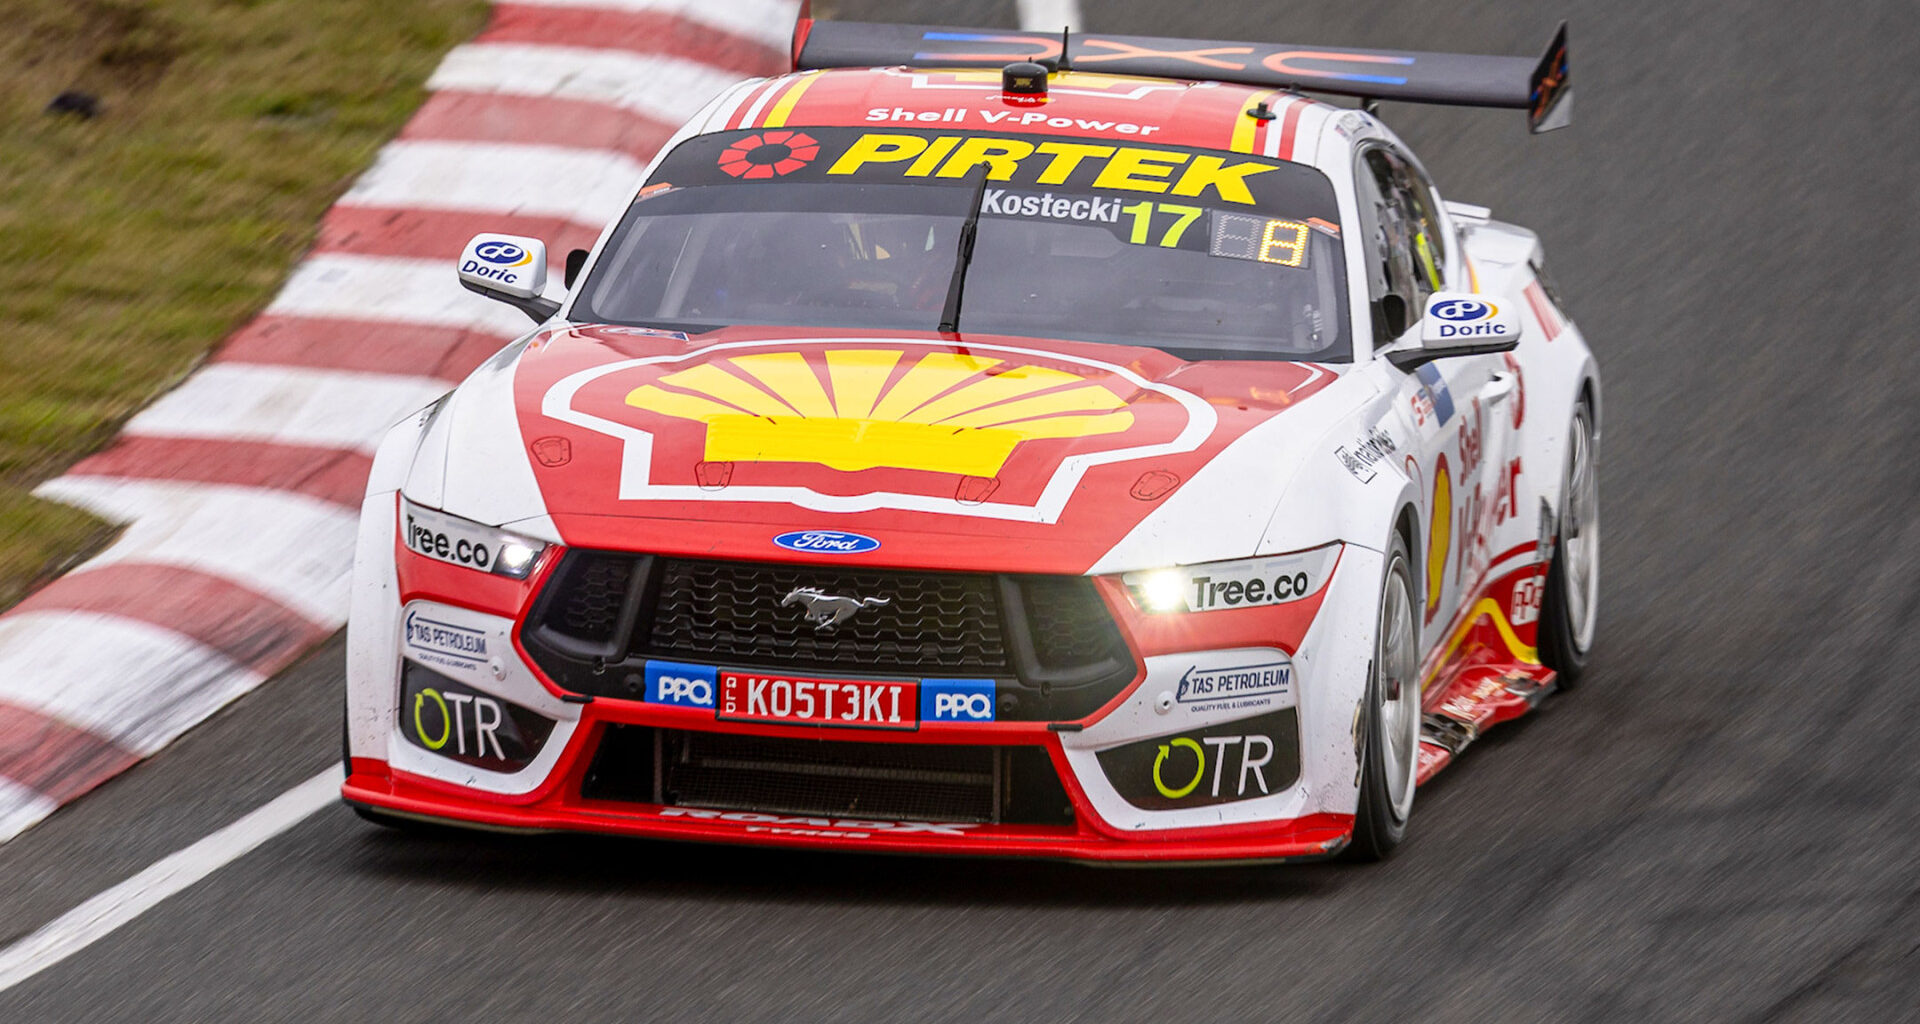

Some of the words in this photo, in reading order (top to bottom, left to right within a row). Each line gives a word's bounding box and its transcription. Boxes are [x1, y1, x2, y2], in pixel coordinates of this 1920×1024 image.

[865, 107, 967, 123] Shell
[979, 110, 1160, 136] V-Power
[826, 133, 1280, 206] PIRTEK
[980, 189, 1123, 223] Kostecki
[1122, 200, 1203, 249] 17
[461, 260, 518, 284] Doric
[1440, 321, 1506, 337] Doric
[406, 513, 491, 569] Tree.co
[793, 533, 860, 550] Ford
[1191, 571, 1309, 609] Tree.co
[415, 624, 432, 643] TAS
[433, 628, 487, 655] PETROLEUM
[658, 675, 713, 705] PPQ
[1191, 676, 1214, 695] TAS
[1217, 669, 1290, 692] PETROLEUM
[935, 693, 992, 719] PPQ
[1191, 703, 1216, 712] QUALITY
[1217, 702, 1231, 711] FUEL
[1237, 699, 1271, 709] LUBRICANTS
[659, 807, 982, 836] ROADX
